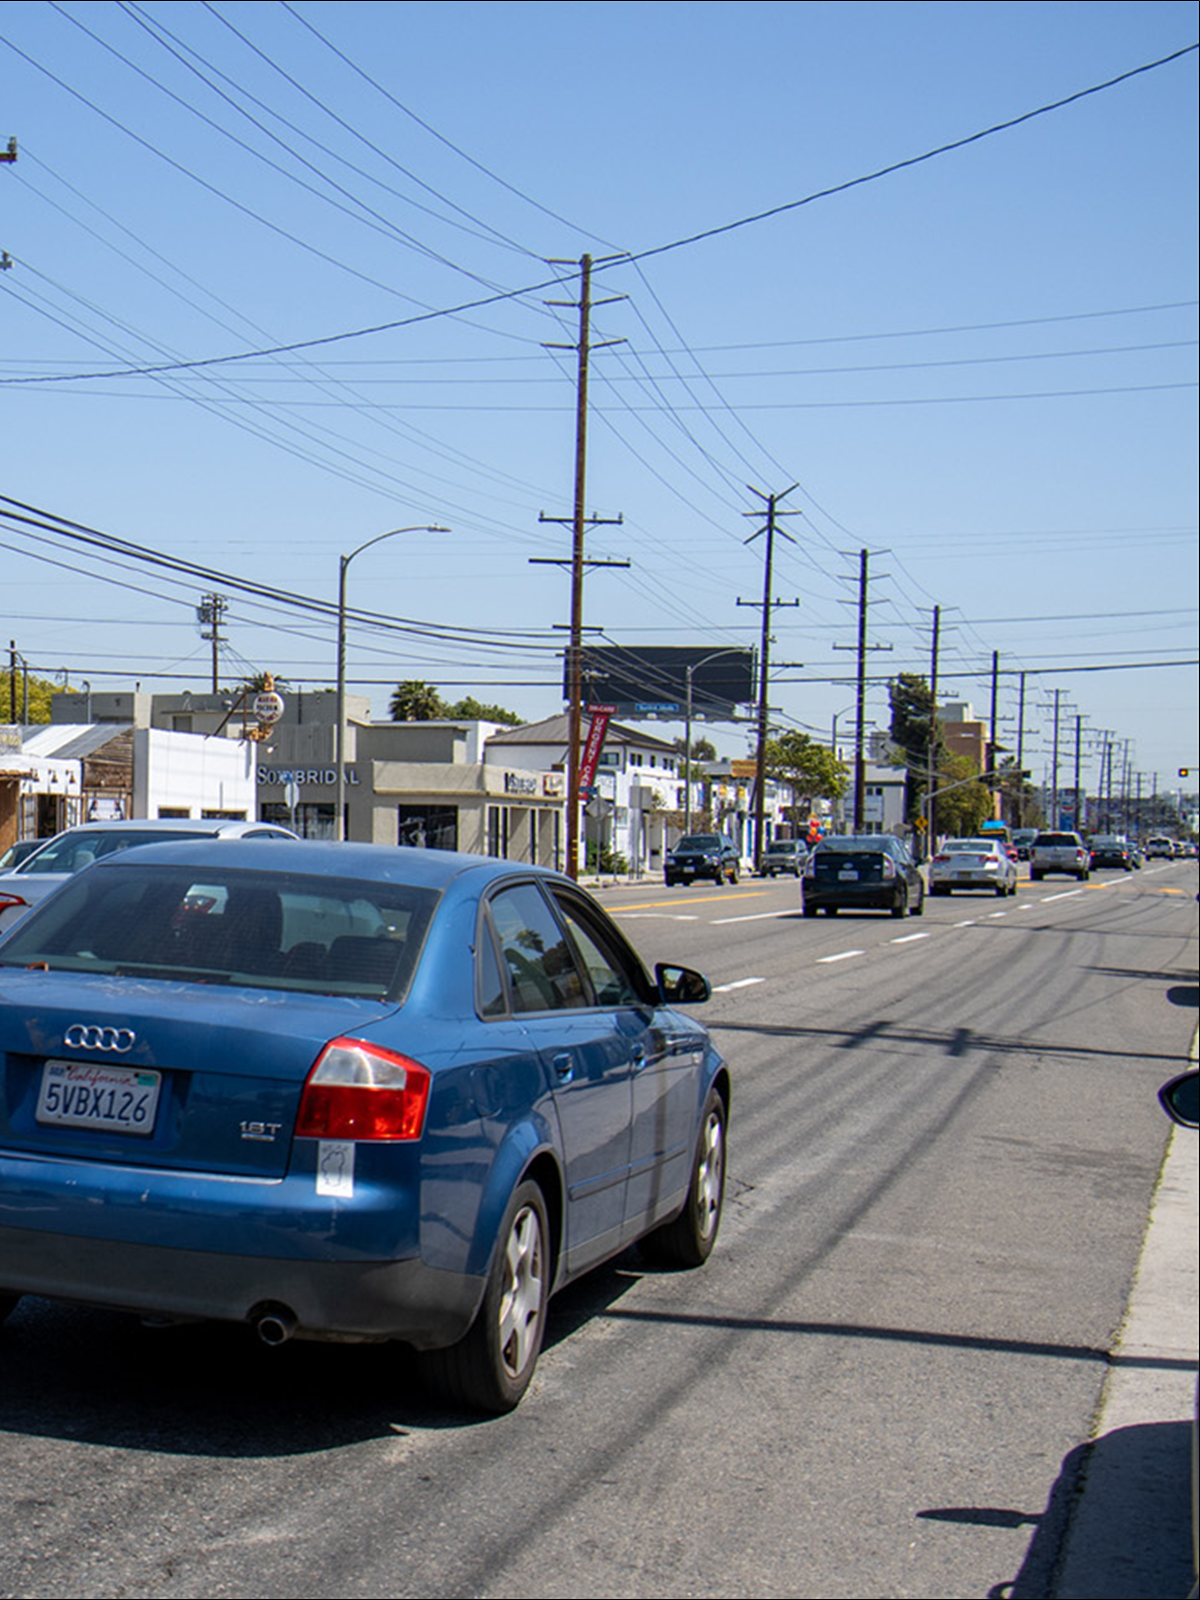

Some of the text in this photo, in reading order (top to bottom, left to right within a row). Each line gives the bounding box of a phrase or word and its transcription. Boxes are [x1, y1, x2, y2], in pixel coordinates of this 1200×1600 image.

[588, 717, 604, 763] URGENT
[67, 1065, 137, 1087] California
[45, 1083, 150, 1122] 5VBX126
